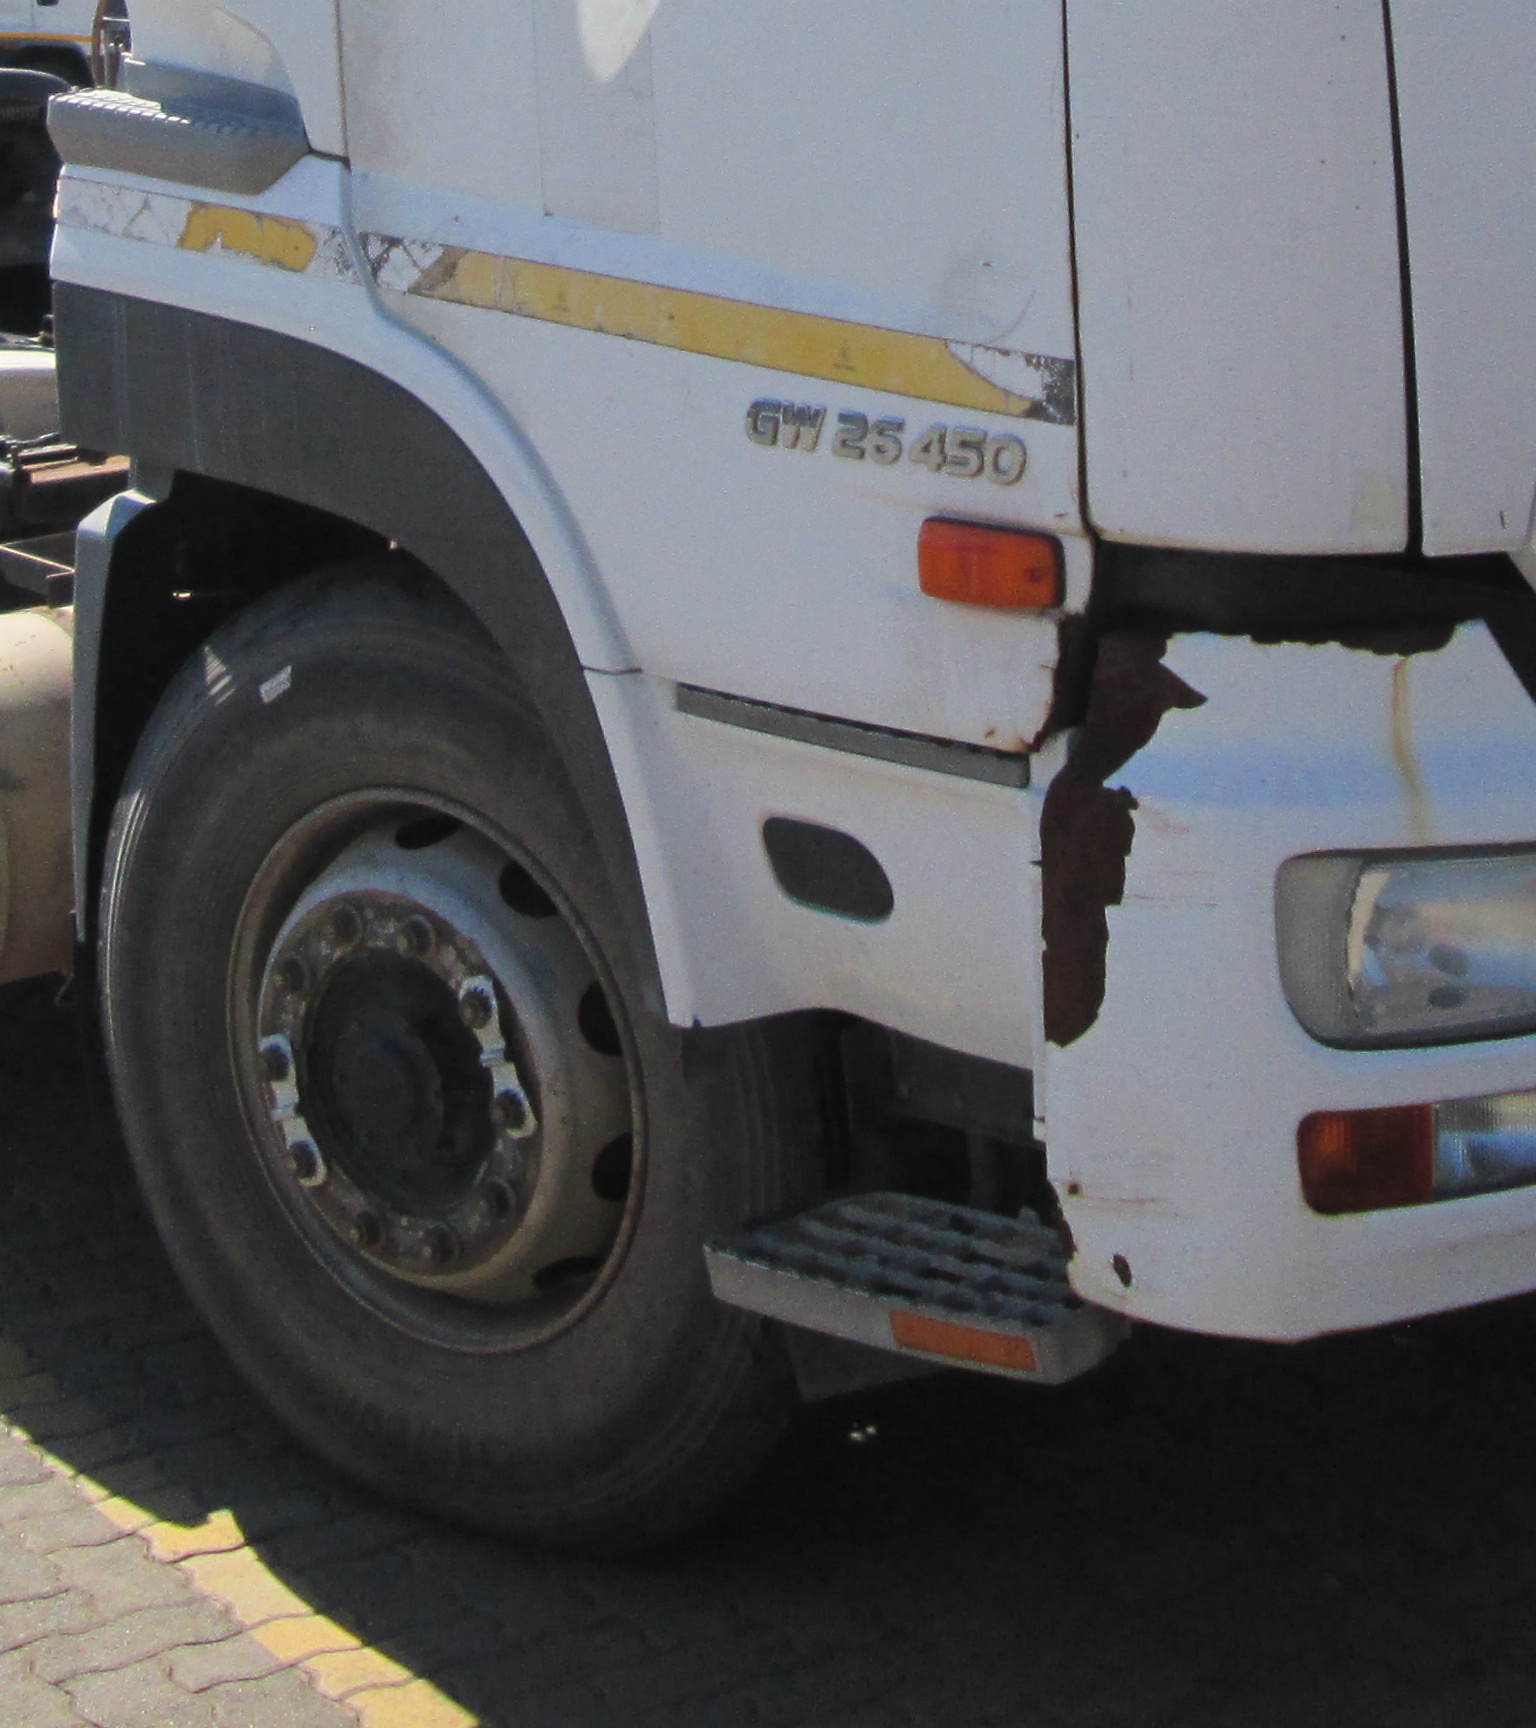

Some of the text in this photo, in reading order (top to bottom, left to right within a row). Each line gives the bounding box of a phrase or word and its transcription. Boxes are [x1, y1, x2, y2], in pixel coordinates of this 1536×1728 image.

[744, 395, 1028, 486] GW 26 450
